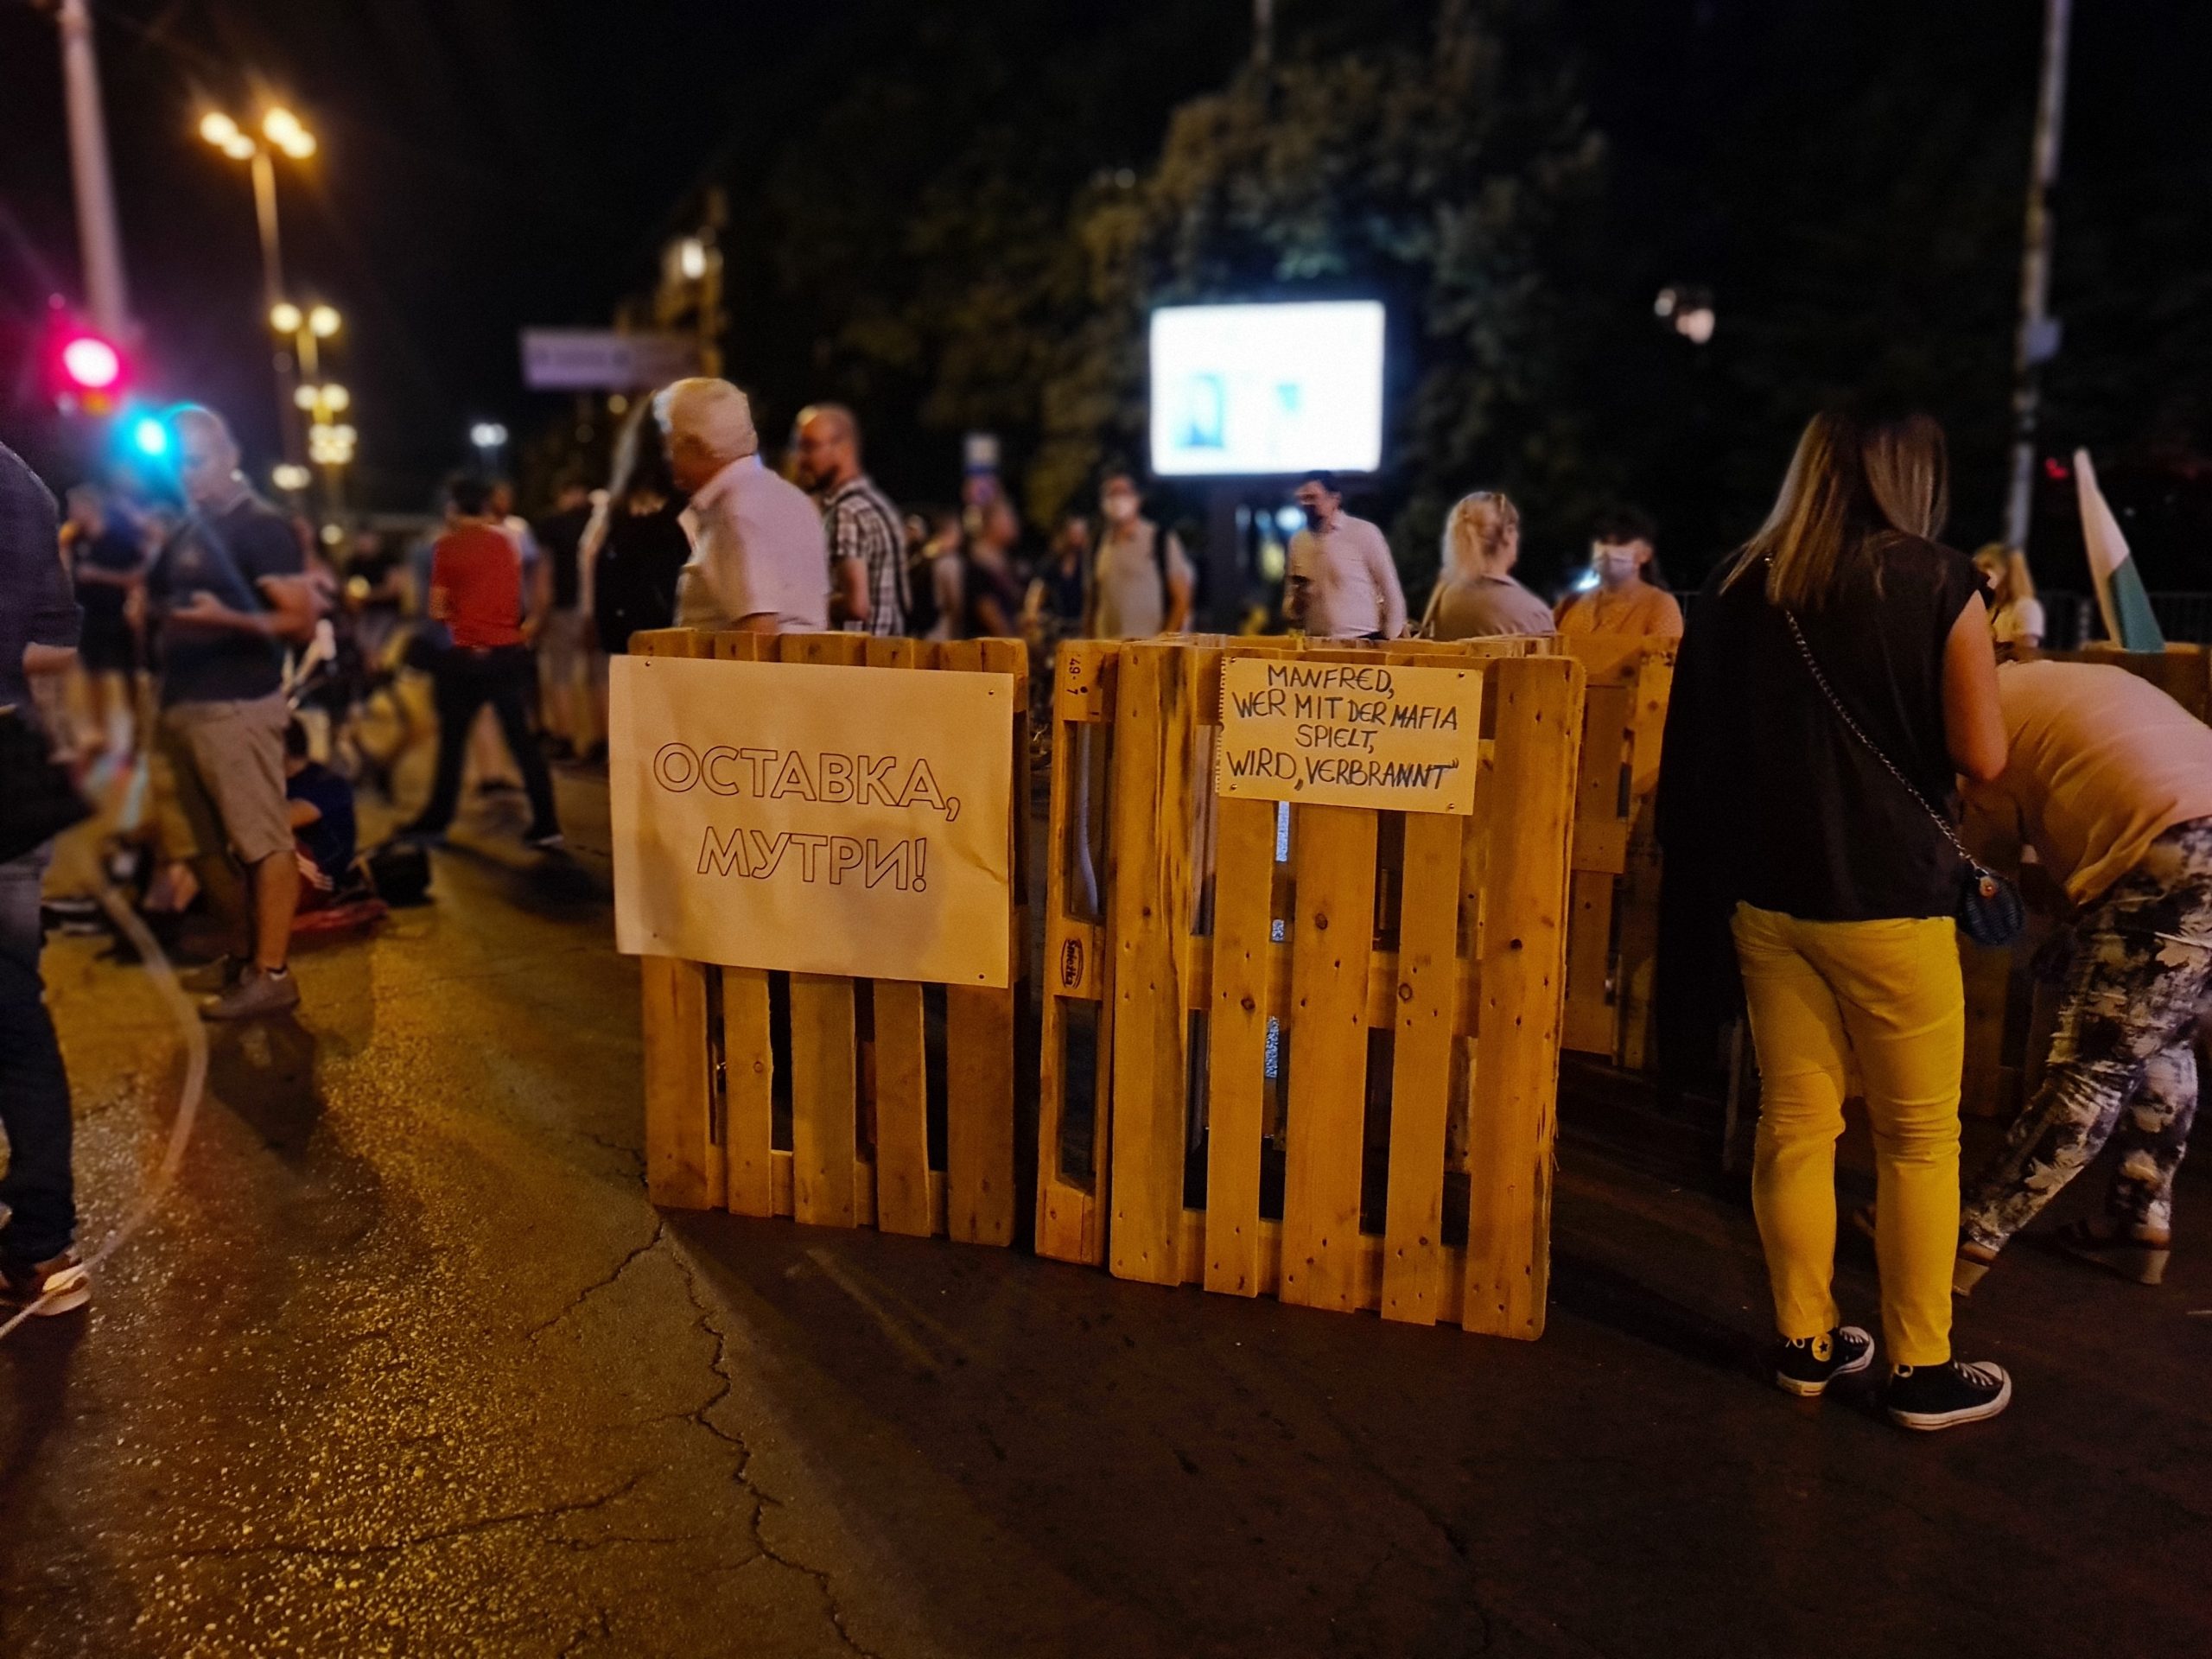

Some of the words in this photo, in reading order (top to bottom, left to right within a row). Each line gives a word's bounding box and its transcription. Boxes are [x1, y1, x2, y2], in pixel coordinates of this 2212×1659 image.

[1268, 664, 1395, 699] MANFRED,
[1232, 689, 1286, 718] WER
[1295, 693, 1343, 719] MIT
[1348, 699, 1387, 725] DER
[1389, 704, 1458, 730] MAFIA
[1294, 724, 1378, 753] SPIELT,
[653, 742, 961, 822] ОСТАВКА,
[697, 826, 927, 892] МУТРИ!
